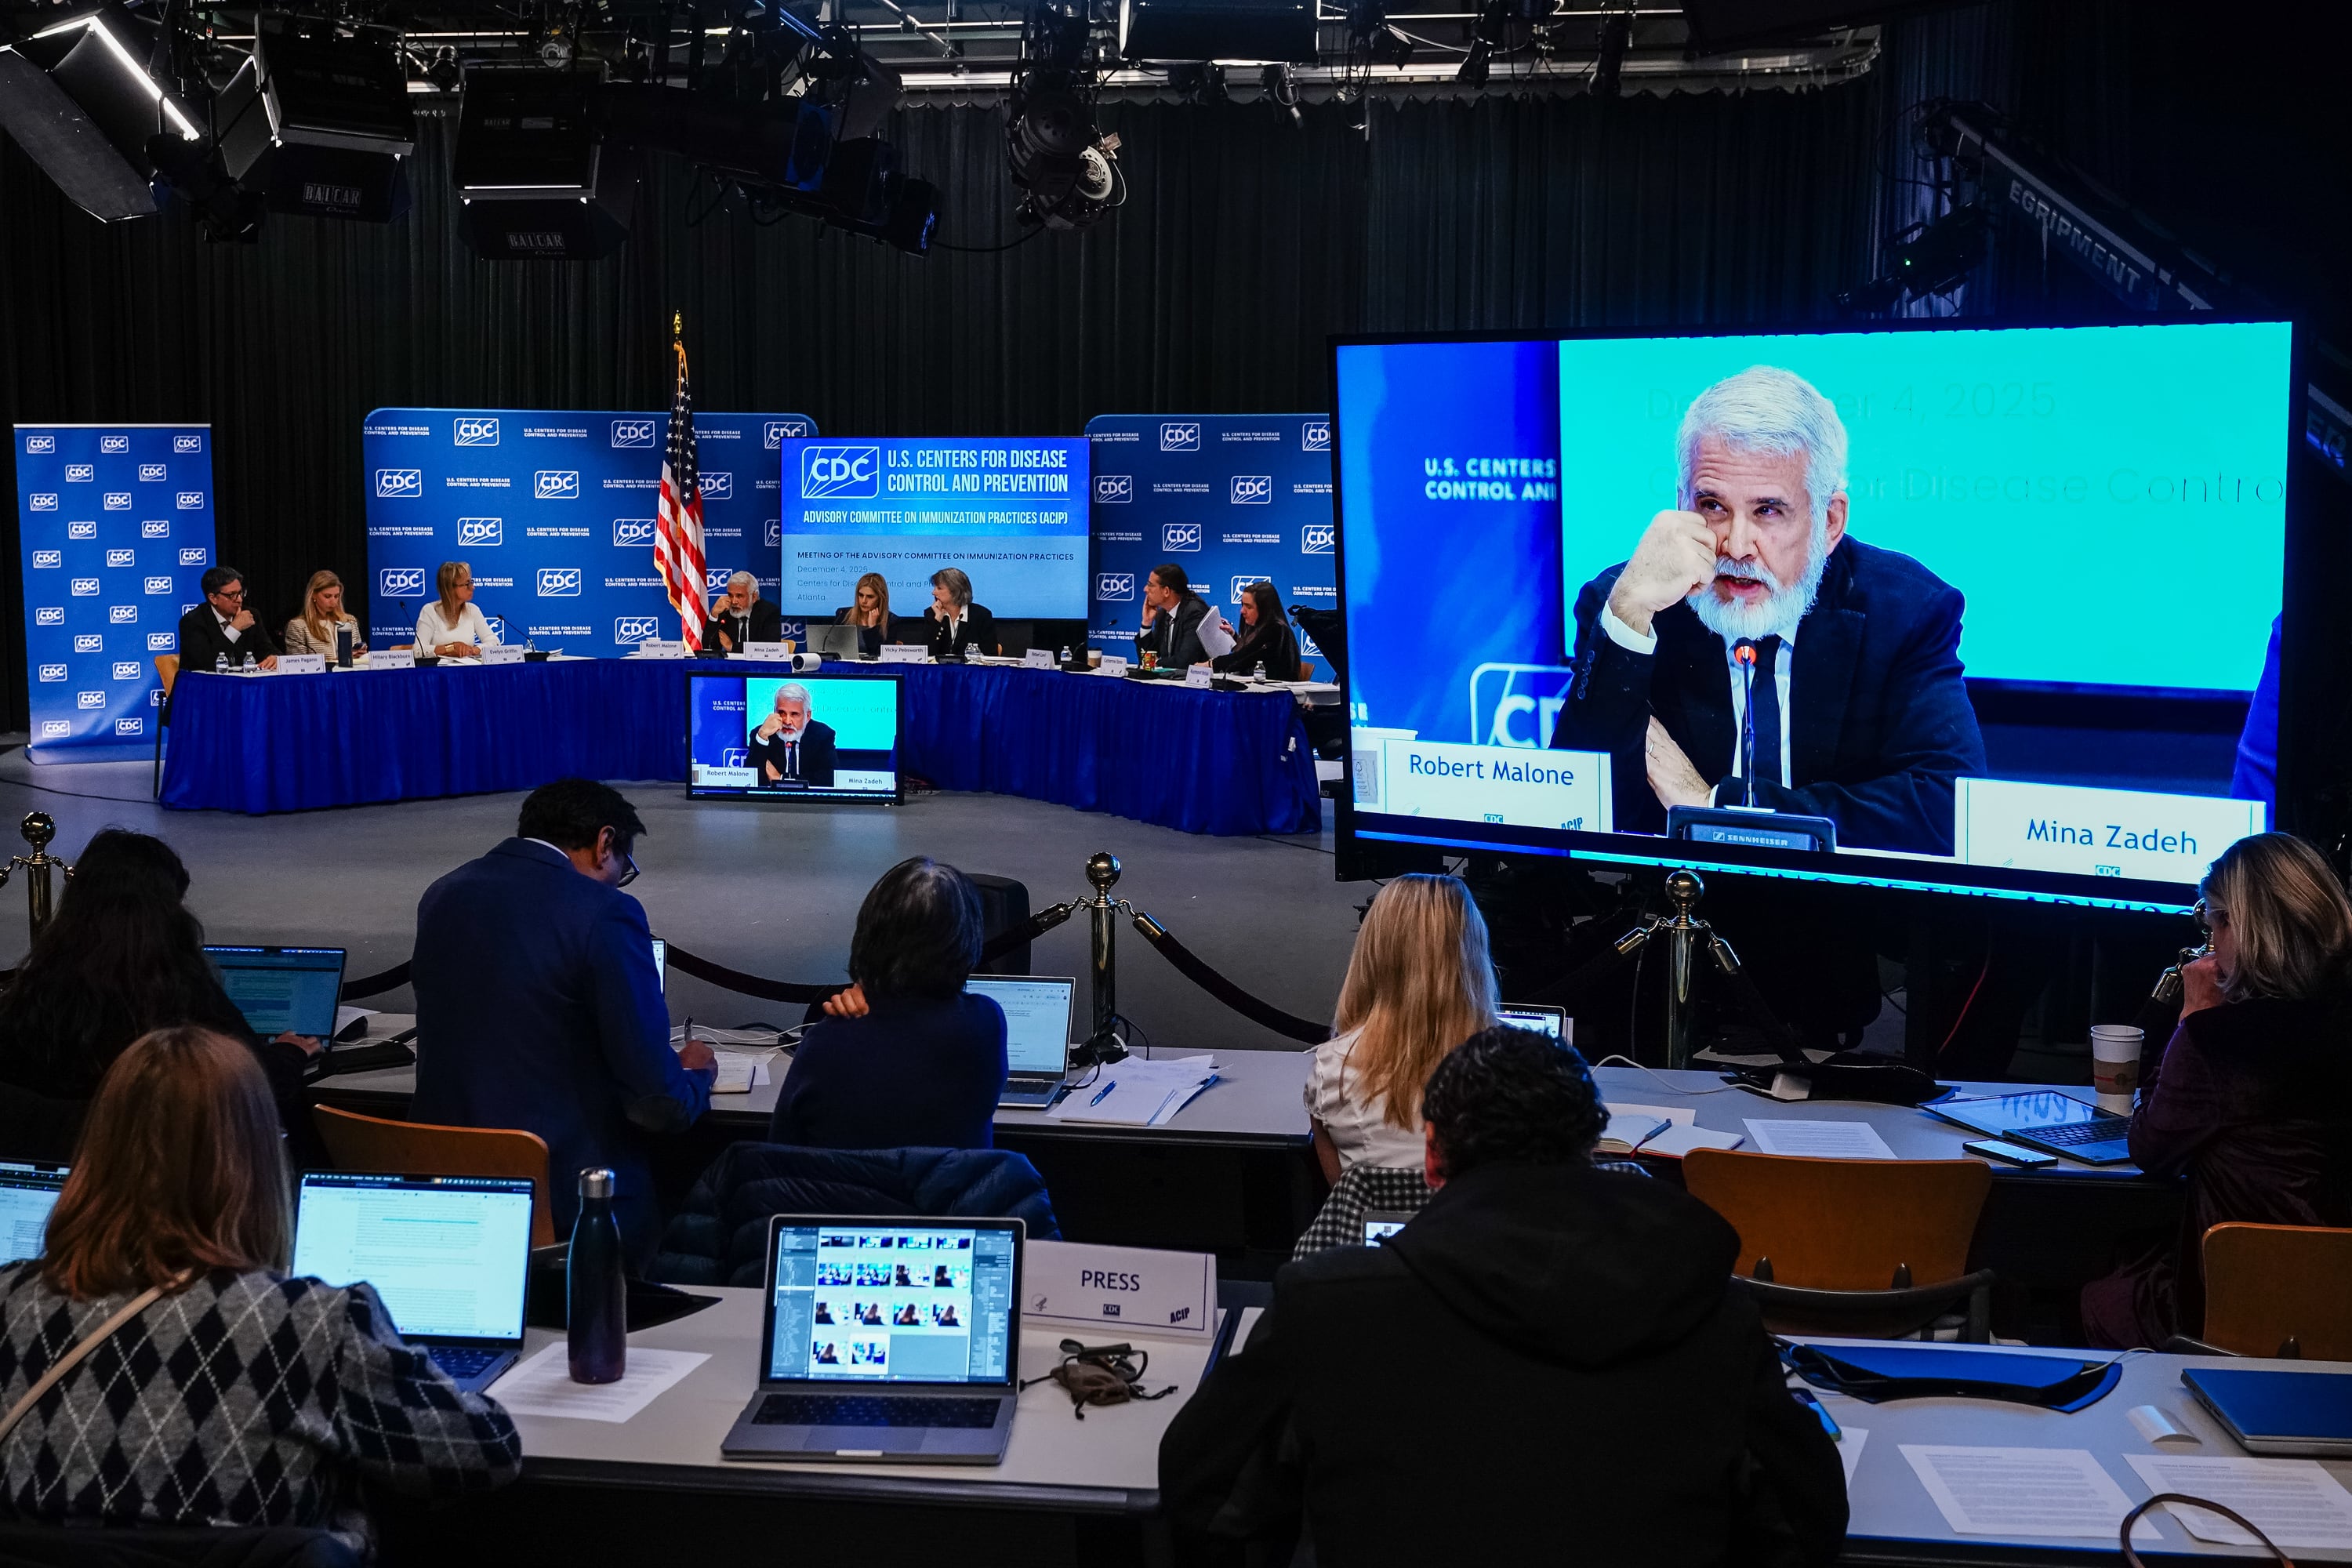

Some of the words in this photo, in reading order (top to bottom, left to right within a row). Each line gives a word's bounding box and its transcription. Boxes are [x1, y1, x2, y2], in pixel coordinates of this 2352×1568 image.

[304, 184, 360, 205] BALCAR
[509, 233, 564, 249] BALCAR
[2009, 180, 2140, 292] EGRIPMENT
[460, 424, 493, 437] CDC
[617, 426, 649, 439] CDC
[1165, 429, 1194, 442] CDC
[30, 439, 52, 448] CDC
[104, 439, 125, 448] CDC
[177, 439, 198, 447] CDC
[888, 450, 913, 468] U.S.
[917, 450, 977, 468] CENTERS
[981, 450, 1007, 468] FOR
[1011, 450, 1067, 468] DISEASE
[68, 467, 90, 477] CDC
[142, 467, 163, 476] CDC
[811, 458, 869, 481] CDC
[1425, 457, 1460, 477] U.S.
[1466, 458, 1556, 478] CENTERS
[382, 475, 415, 488] CDC
[540, 477, 572, 490] CDC
[888, 474, 948, 492] CONTROL
[952, 474, 980, 492] AND
[984, 474, 1068, 492] PREVENTION
[1099, 482, 1127, 494] CDC
[1236, 482, 1265, 495] CDC
[1425, 480, 1516, 501] CONTROL
[1521, 481, 1557, 501] AN
[33, 497, 55, 506] CDC
[107, 496, 128, 505] CDC
[180, 495, 200, 504] CDC
[804, 511, 848, 523] ADVISORY
[850, 511, 902, 523] COMMITTEE
[904, 511, 916, 523] ON
[919, 512, 985, 524] IMMUNIZATION
[988, 512, 1037, 524] PRACTICES
[1040, 512, 1068, 524] (ACIP)
[72, 525, 93, 534] CDC
[145, 524, 166, 532] CDC
[463, 524, 495, 537] CDC
[619, 525, 650, 537] CDC
[1168, 530, 1196, 543] CDC
[36, 554, 58, 563] CDC
[110, 553, 131, 562] CDC
[183, 551, 203, 560] CDC
[75, 581, 96, 590] CDC
[148, 580, 169, 589] CDC
[386, 575, 419, 588] CDC
[543, 574, 575, 587] CDC
[1102, 579, 1128, 592] CDC
[39, 610, 61, 619] CDC
[113, 609, 134, 618] CDC
[621, 623, 652, 635] CDC
[78, 638, 99, 647] CDC
[151, 636, 172, 645] CDC
[43, 667, 64, 677] CDC
[116, 665, 137, 674] CDC
[81, 694, 103, 704] CDC
[119, 721, 140, 730] CDC
[1494, 694, 1565, 749] CD
[46, 724, 67, 732] CDC
[1410, 754, 1484, 779] Robert
[1493, 760, 1574, 786] Malone
[1485, 814, 1503, 823] CDC
[1561, 817, 1583, 831] ACIP
[1728, 834, 1788, 846] SENNHEISER
[2027, 818, 2093, 846] Mina
[2106, 825, 2197, 854] Zadeh
[2096, 866, 2120, 877] CDC
[1082, 1270, 1140, 1291] PRESS
[1104, 1305, 1120, 1313] CDC
[1170, 1307, 1190, 1324] ACIP
